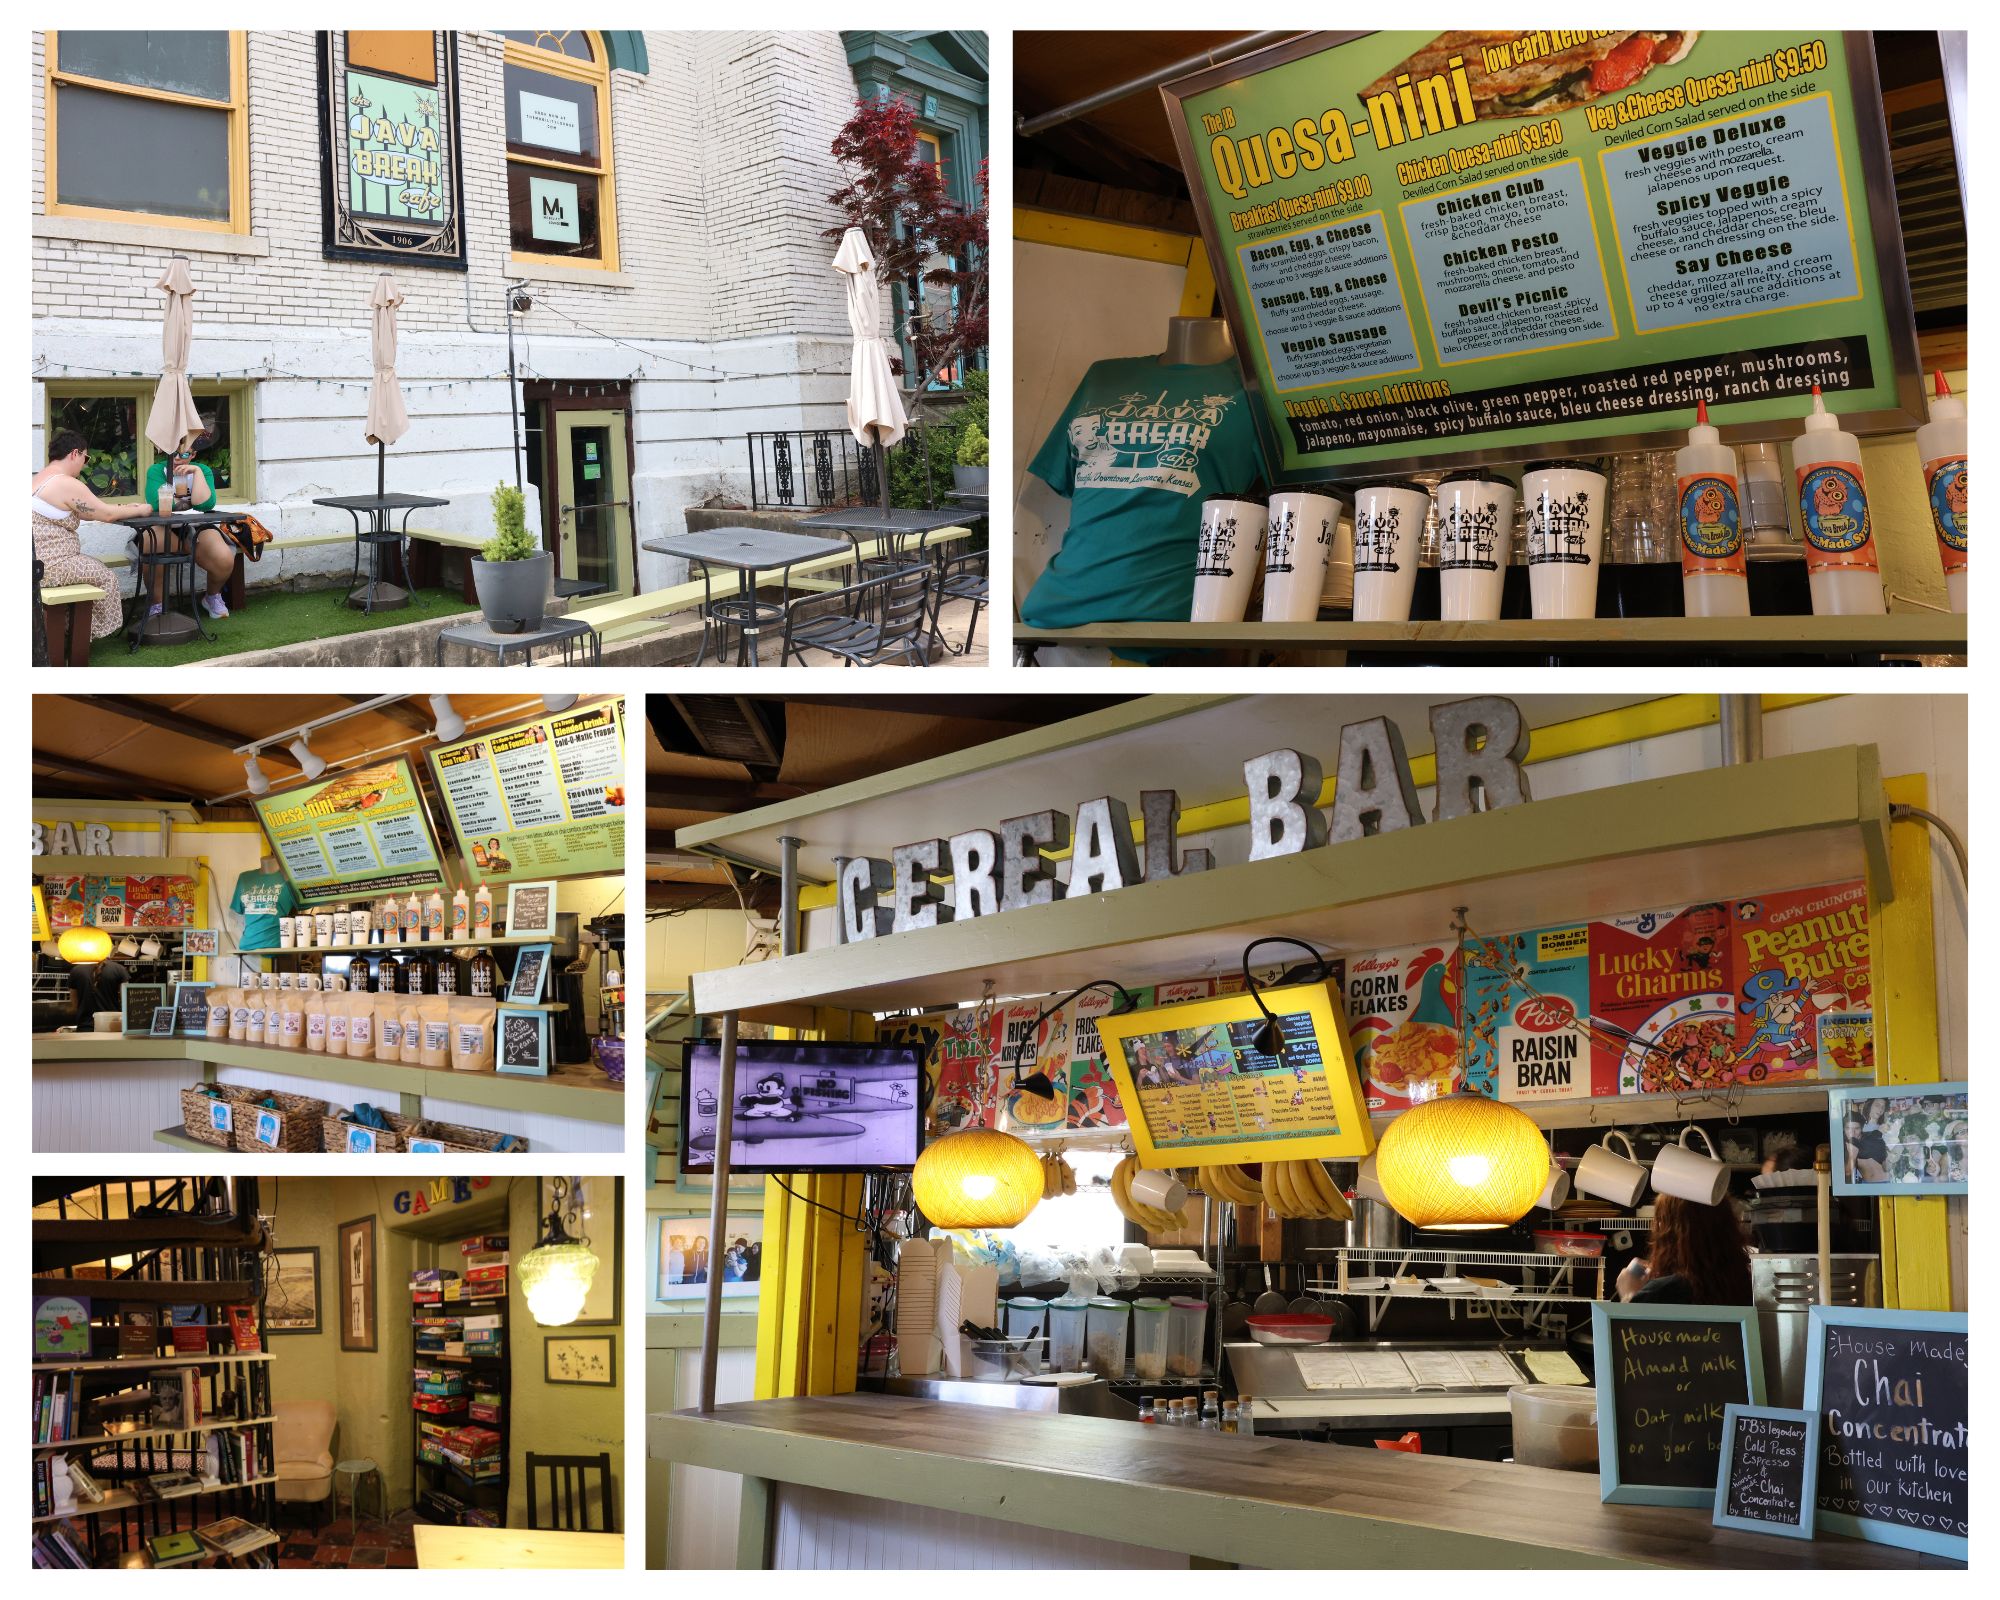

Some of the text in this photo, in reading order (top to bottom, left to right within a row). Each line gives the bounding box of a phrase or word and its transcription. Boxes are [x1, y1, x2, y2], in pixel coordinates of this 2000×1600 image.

[1481, 44, 1512, 76] low
[1510, 31, 1546, 66] carb
[1584, 103, 1618, 133] Veg
[1683, 57, 1775, 107] Quesa-nini
[1772, 38, 1827, 81] $9.50
[350, 95, 372, 108] the
[1200, 105, 1236, 135] The JB
[1210, 55, 1478, 200] Quesa-nini
[351, 115, 439, 152] JAVA
[1637, 115, 1785, 163] Veggie Deluxe
[1395, 117, 1563, 186] Chicken Quesa-nini $9.50
[353, 149, 438, 186] BREAK
[399, 188, 441, 213] cafe
[1229, 173, 1372, 232] Breakfast Quesa-nini $9.00
[1436, 177, 1544, 216] Chicken Club
[1656, 175, 1789, 215] Spicy Veggie
[392, 235, 413, 246] 1906
[1249, 222, 1371, 262] Bacon, Egg, & Cheese
[1443, 232, 1558, 267] Chicken Pesto
[1675, 242, 1792, 274] Say Cheese
[1260, 272, 1387, 308] Sausage, Egg, & Cheese
[1458, 286, 1568, 317] Devil's Picnic
[1280, 325, 1386, 353] Veggie Sausage
[1284, 380, 1451, 417] Veggie & Sauce Additions
[1299, 350, 1847, 432] tomato, red onion, black olive, green pepper, roasted red pepper, mushrooms,
[1105, 404, 1223, 426] JAVA
[1305, 368, 1849, 450] jalapeno, mayonnaise, spicy buffalo sauce, bleu cheese dressing, ranch dressing
[1105, 422, 1212, 449] BREAK
[1158, 451, 1196, 468] cafe
[1166, 474, 1194, 489] Kansas
[555, 717, 608, 738] Blended Drinks
[567, 786, 604, 800] Smoothies
[266, 796, 336, 829] Quesa-nini
[837, 696, 1530, 943] CEREAL BAR
[100, 906, 121, 916] RAISIN
[102, 914, 119, 923] BRAN
[1769, 906, 1804, 924] CAP'N
[1541, 938, 1587, 949] BOMBER
[1567, 930, 1587, 939] JET
[1742, 902, 1869, 964] Peanut
[1351, 957, 1400, 973] Kellogg's
[1600, 946, 1678, 977] Lucky
[1350, 974, 1399, 998] CORN
[1616, 968, 1723, 999] Charms
[1008, 1006, 1038, 1019] Kellogg's
[1078, 995, 1110, 1009] Kellogg's
[1350, 995, 1408, 1016] FLAKES
[1520, 1004, 1569, 1026] Post
[943, 1032, 996, 1059] Trix
[1292, 1042, 1318, 1052] $4.75
[1512, 1034, 1578, 1062] RAISIN
[816, 1079, 836, 1089] NO
[1517, 1061, 1571, 1087] BRAN
[803, 1087, 850, 1100] FISHING
[394, 1176, 491, 1216] GAMES
[1836, 1337, 1965, 1360] House Made
[1623, 1356, 1737, 1384] Almond milk
[1854, 1358, 1924, 1408] Chai
[1677, 1381, 1692, 1392] or
[1634, 1404, 1725, 1428] Oat milk
[1739, 1419, 1806, 1441] JB's legendary
[1744, 1436, 1797, 1456] Cold Press
[1742, 1453, 1790, 1468] Espresso
[1826, 1445, 1968, 1481] Bottled with love
[1760, 1479, 1784, 1495] Chai
[1840, 1476, 1853, 1491] in
[1866, 1480, 1891, 1495] our
[1740, 1493, 1796, 1509] Concentrate
[1729, 1504, 1799, 1525] by the bottle!
